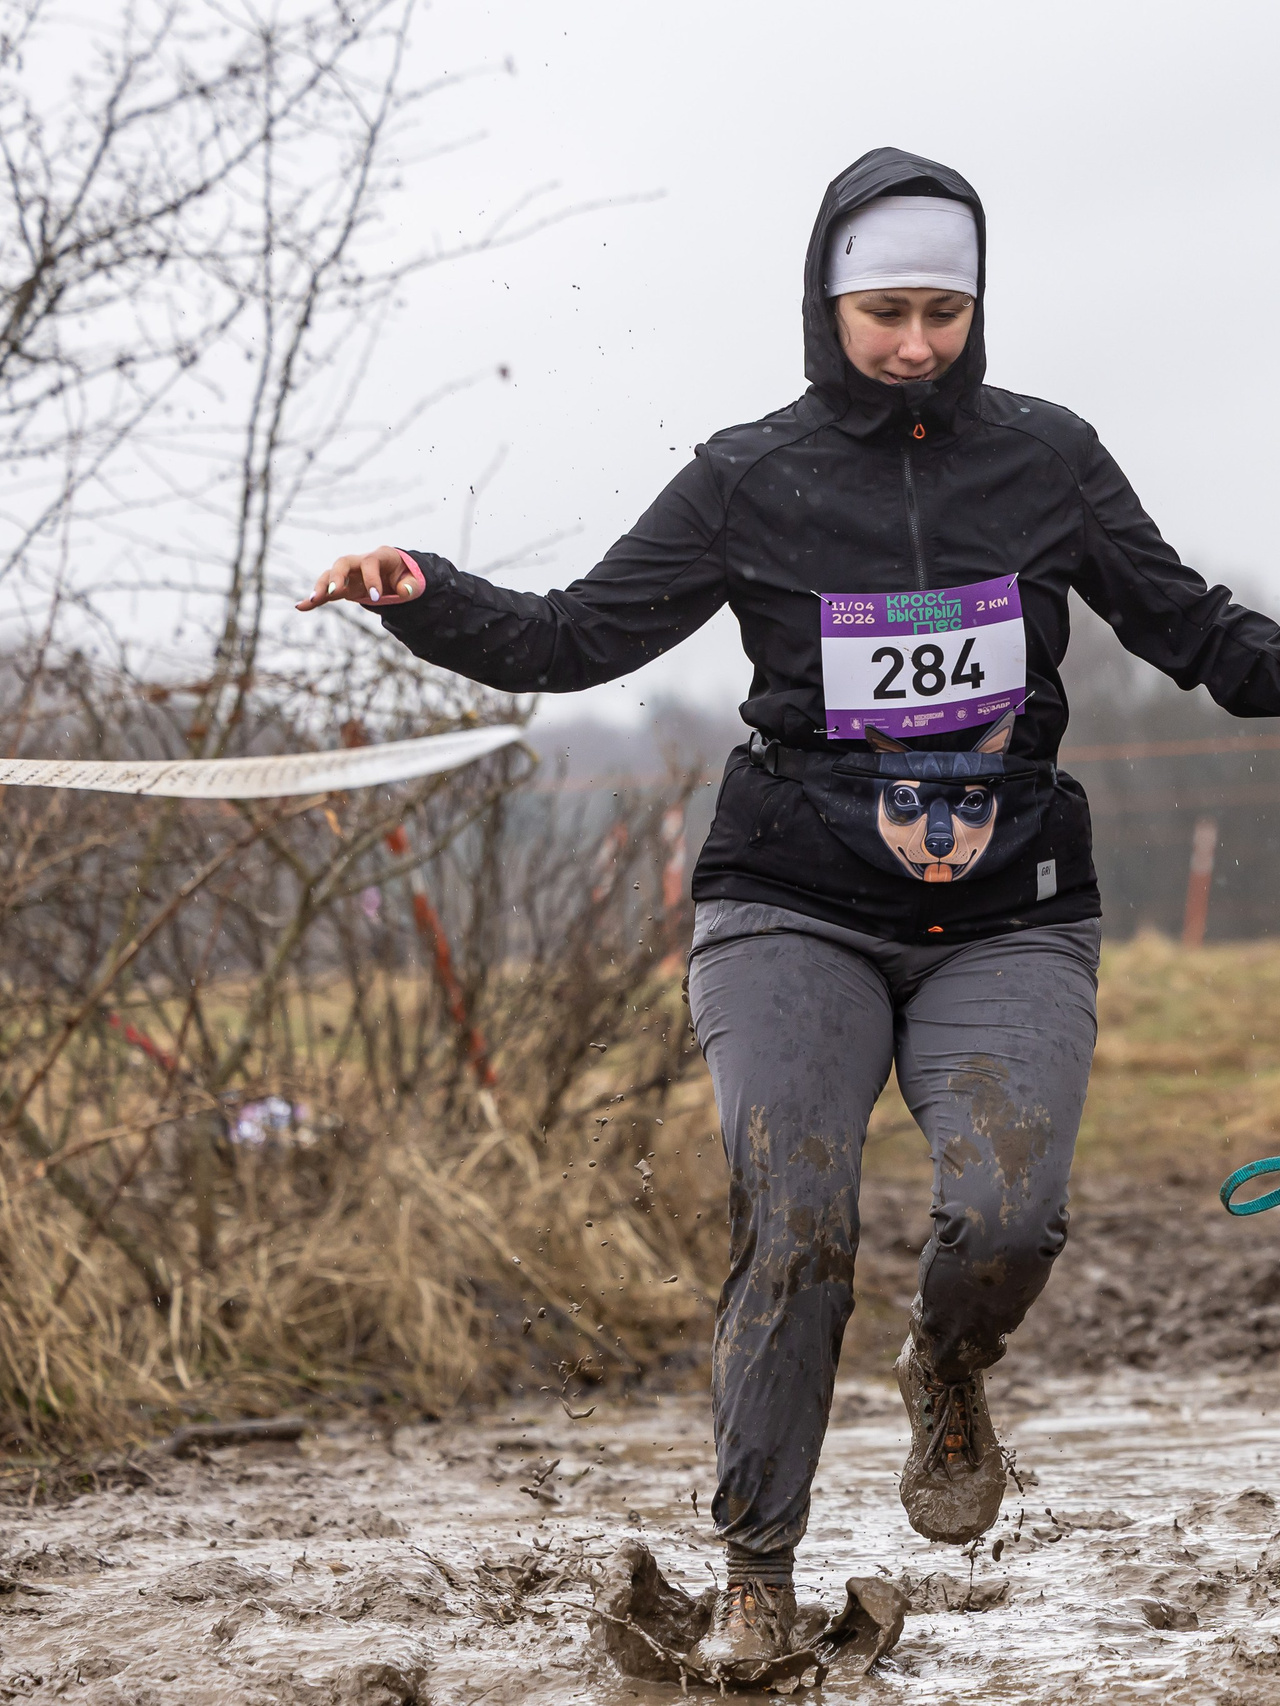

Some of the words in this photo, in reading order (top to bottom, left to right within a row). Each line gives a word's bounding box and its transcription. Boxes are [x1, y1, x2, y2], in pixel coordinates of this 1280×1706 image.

[831, 601, 875, 611] 11/04
[886, 592, 945, 608] КРОСС
[976, 600, 986, 612] 2
[989, 596, 1009, 609] КМ
[832, 613, 876, 624] 2026
[887, 599, 962, 623] БЫСТРЫЙ
[871, 637, 985, 700] 284
